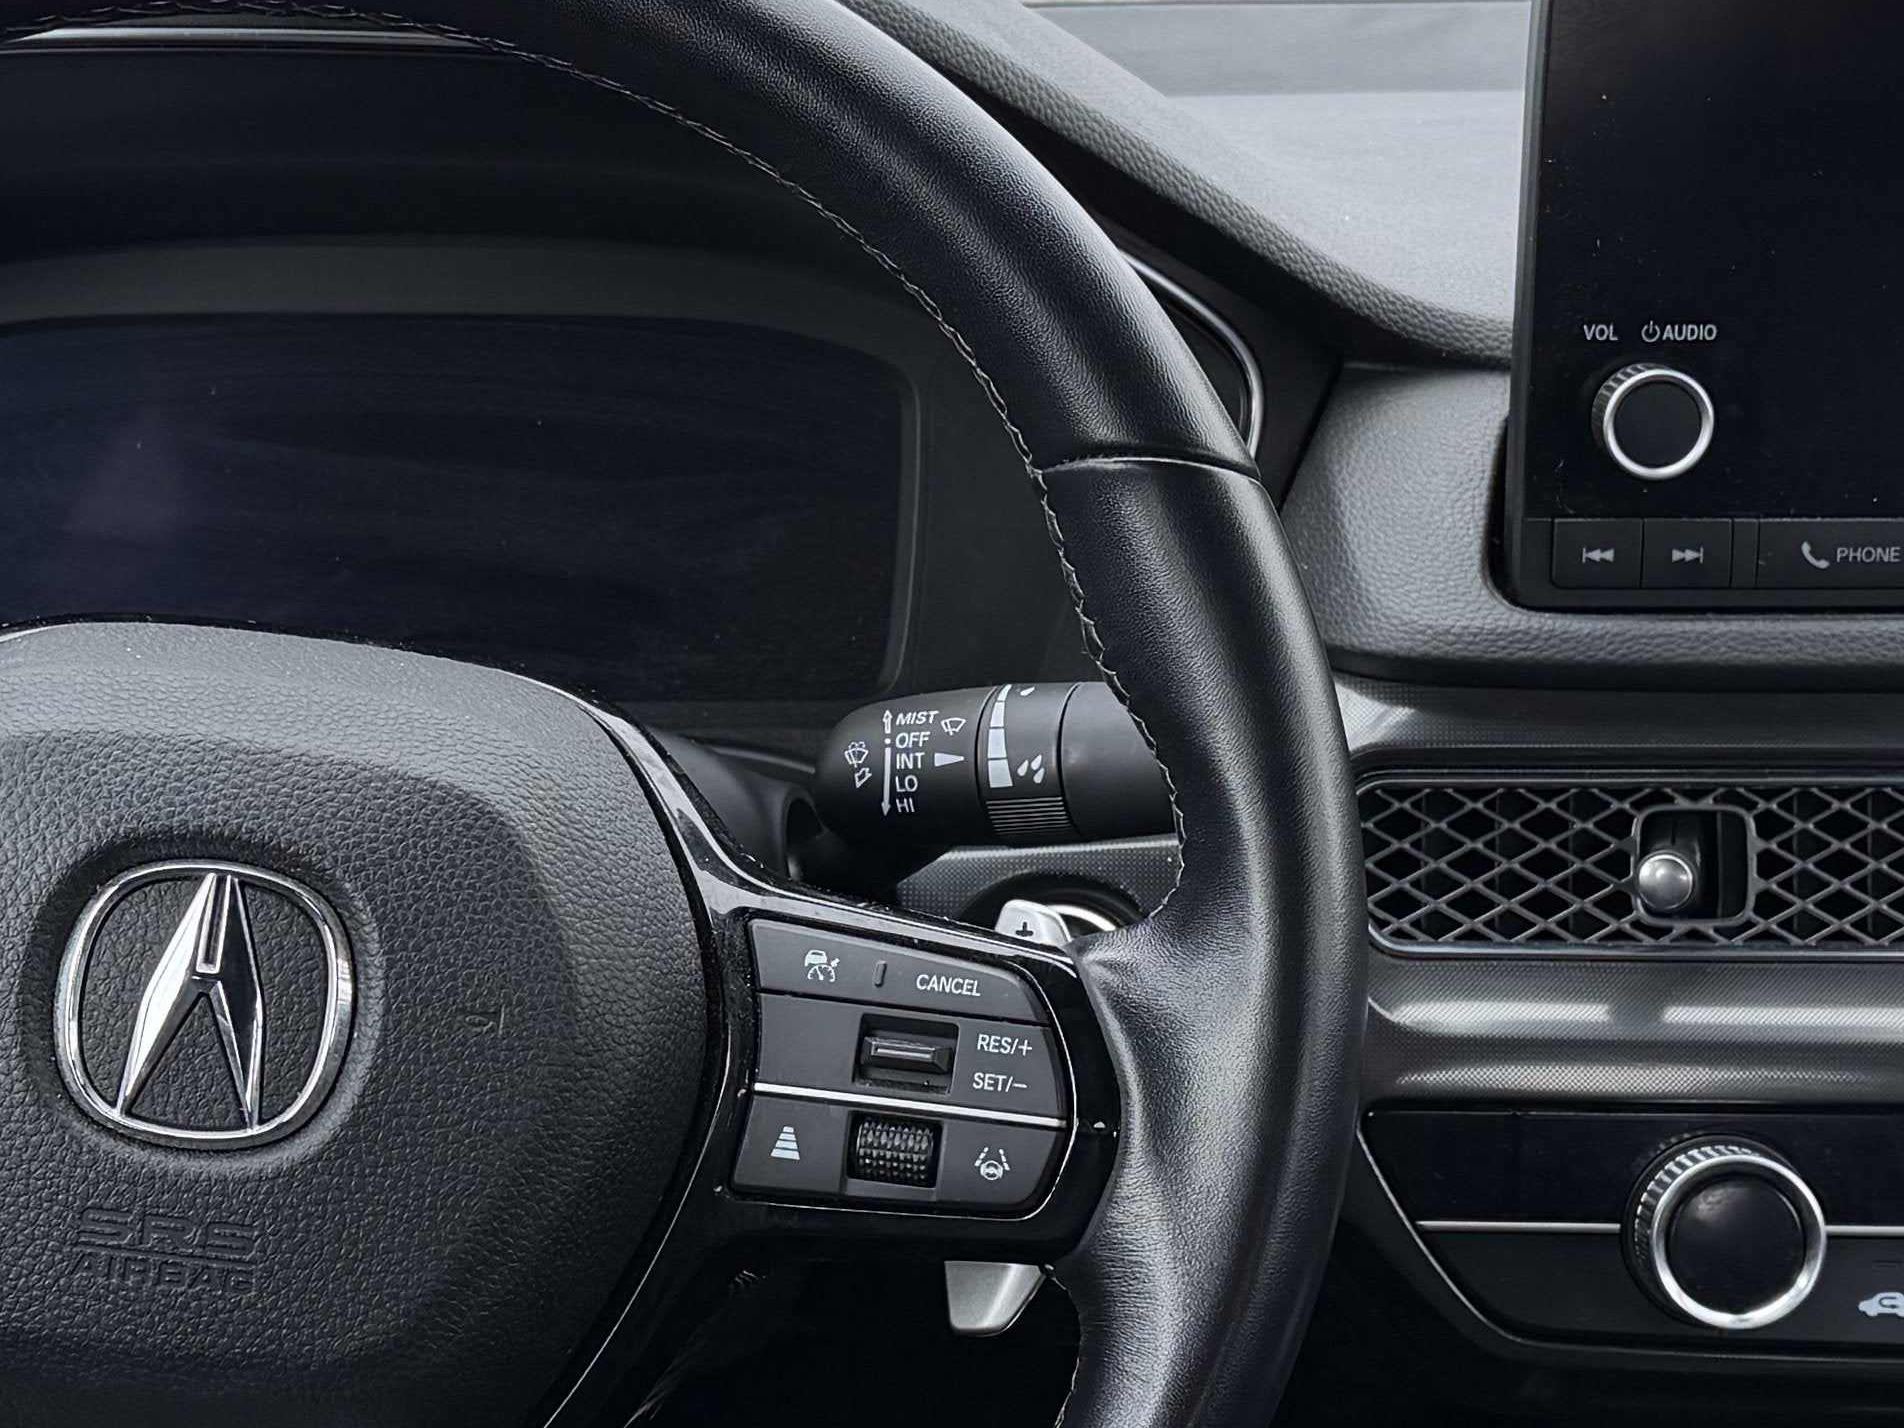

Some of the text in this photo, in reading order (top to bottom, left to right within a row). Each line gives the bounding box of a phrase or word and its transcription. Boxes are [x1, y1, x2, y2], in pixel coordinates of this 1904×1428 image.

[1584, 324, 1717, 340] VOL AUDIO
[1837, 547, 1900, 562] PHONE
[896, 711, 939, 725] MIST
[896, 731, 930, 748] OFF
[897, 752, 925, 769] INT
[896, 775, 917, 792] LO
[896, 798, 914, 812] HI
[916, 974, 981, 997] CANCEL
[75, 1206, 260, 1262] SRS
